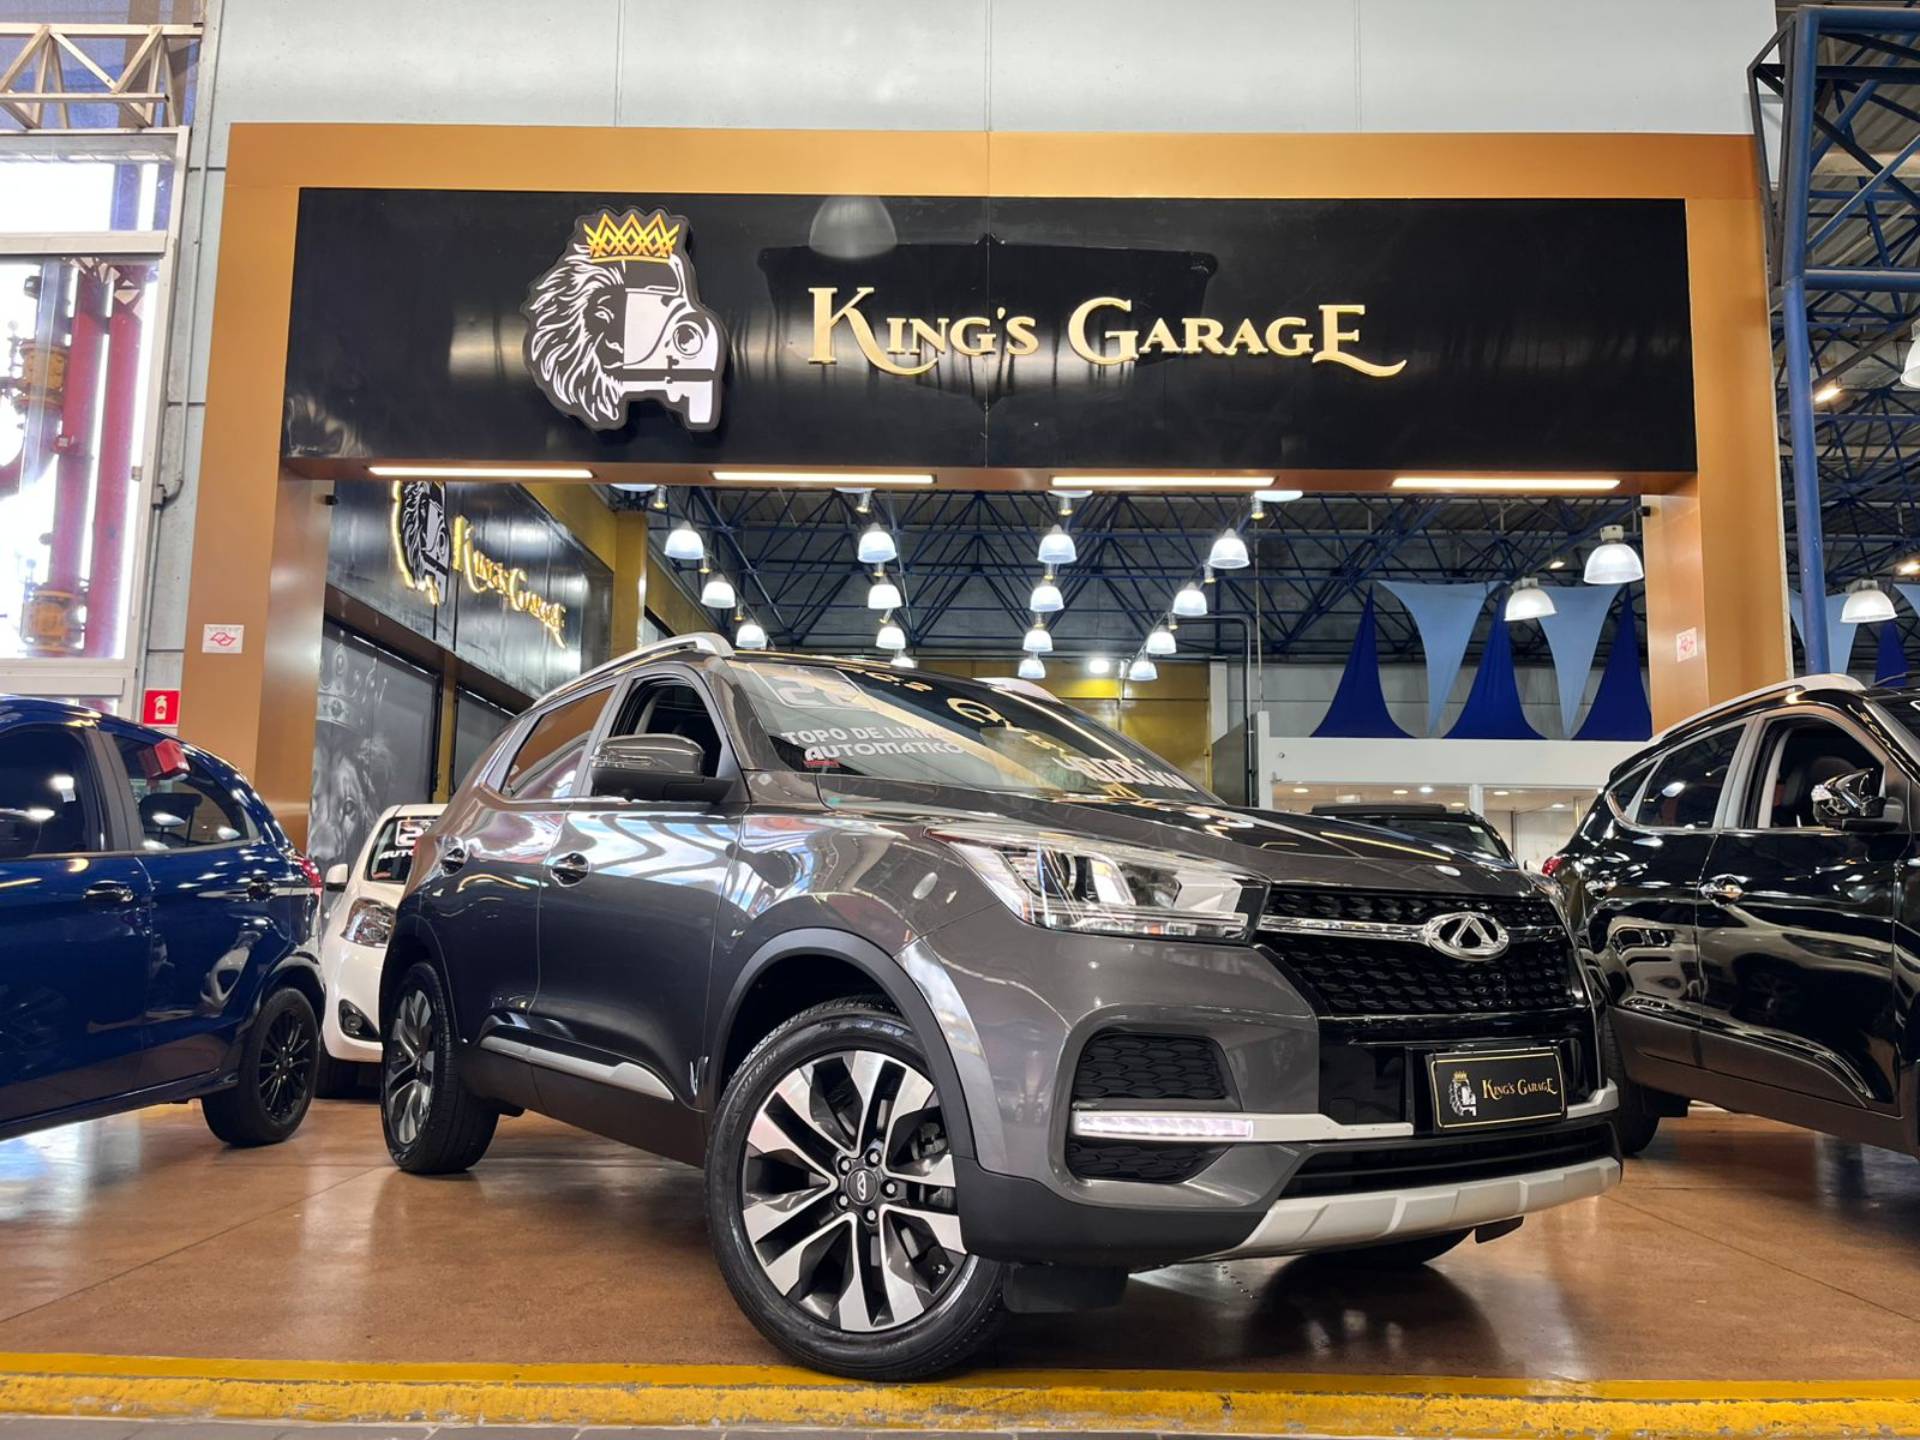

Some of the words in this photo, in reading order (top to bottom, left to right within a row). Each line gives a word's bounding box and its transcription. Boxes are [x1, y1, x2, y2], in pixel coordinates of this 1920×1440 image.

[807, 287, 1039, 376] KING'S
[1067, 296, 1407, 378] GARAGE
[781, 727, 849, 746] TOPO
[850, 726, 884, 741] DE
[1481, 1079, 1516, 1100] KING'S
[1517, 1077, 1558, 1096] GARAGE
